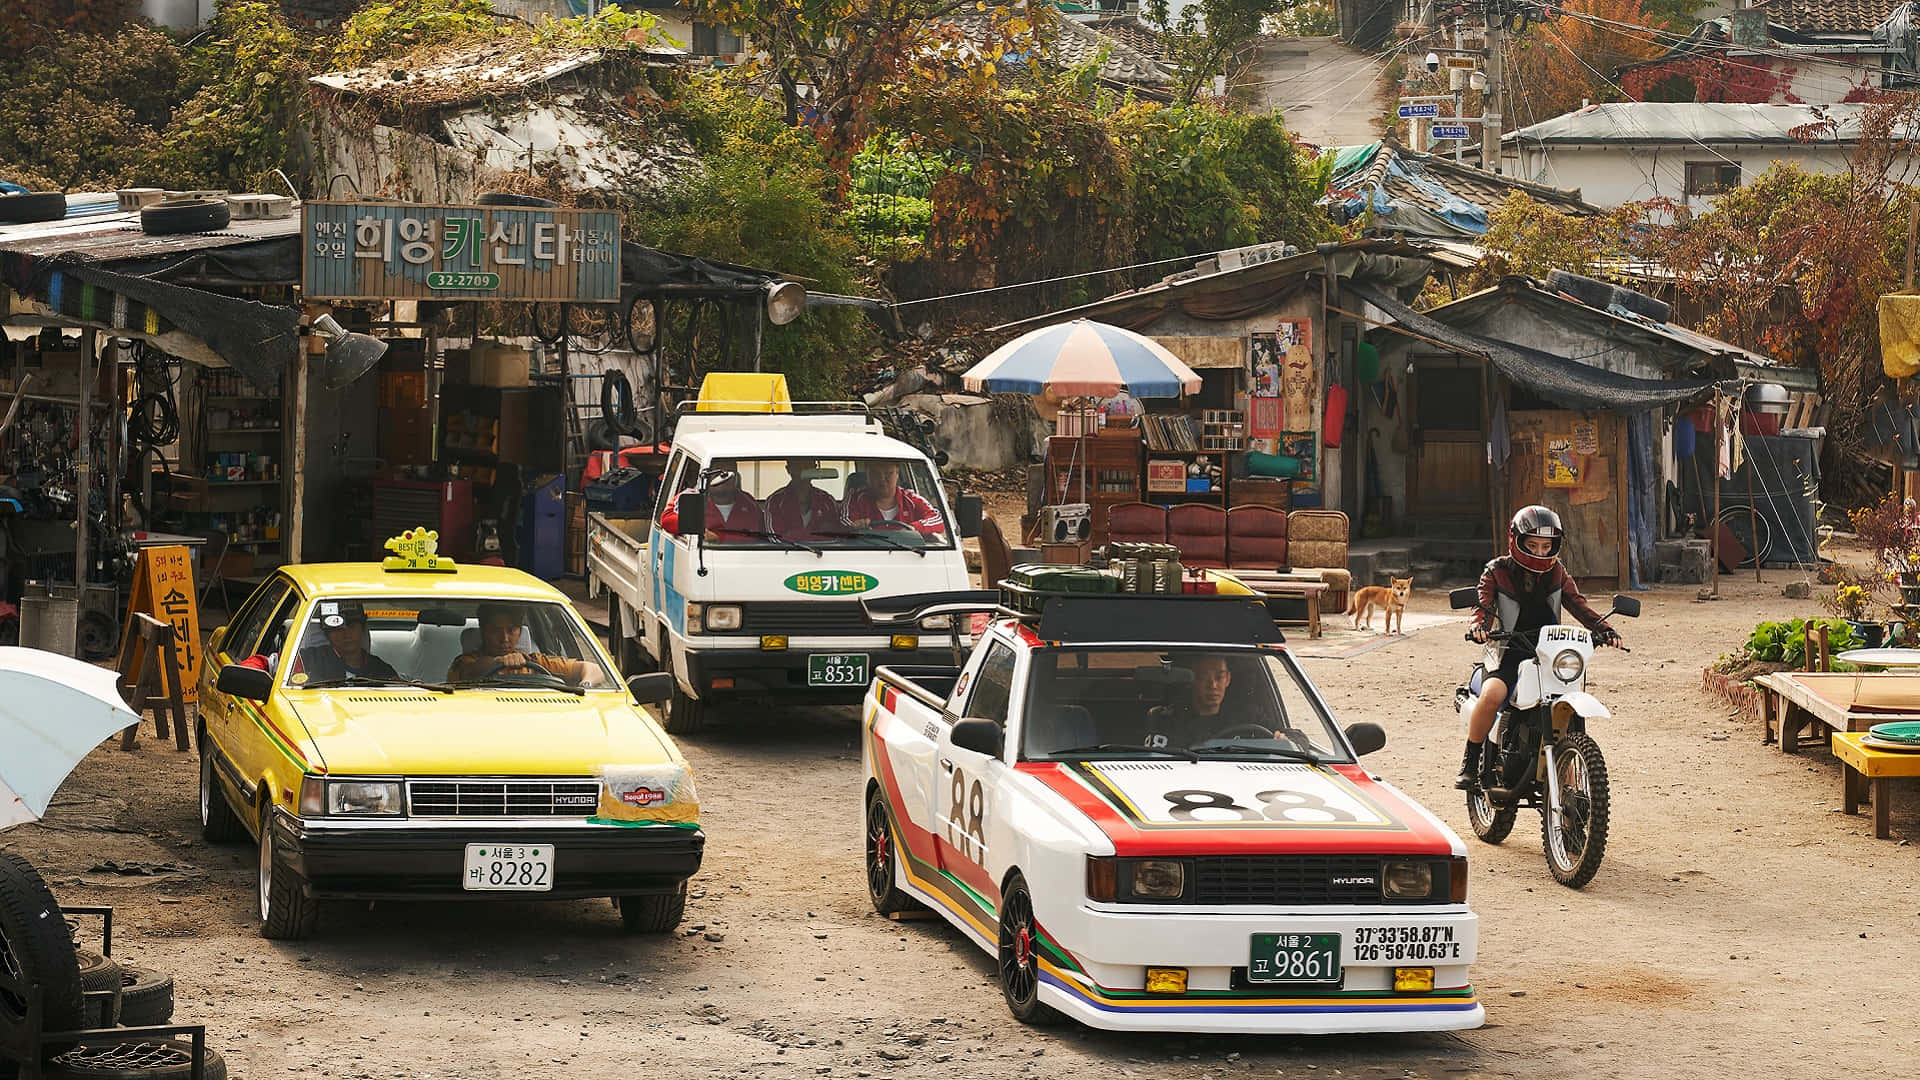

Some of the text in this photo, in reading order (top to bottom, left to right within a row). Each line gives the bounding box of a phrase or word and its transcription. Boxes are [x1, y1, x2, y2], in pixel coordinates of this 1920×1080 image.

[354, 215, 571, 267] 희영카센타
[315, 242, 345, 259] 오일
[437, 275, 490, 287] 32-2709
[398, 542, 413, 552] BEST
[796, 575, 867, 592] 희영카센타
[1547, 627, 1588, 643] HUSTLER
[826, 656, 849, 665] 서울 7
[812, 665, 863, 682] 고 8531
[555, 796, 595, 804] HYUNDAI
[1163, 789, 1358, 822] 88
[948, 767, 985, 868] 88
[491, 847, 525, 859] 서울 3
[470, 862, 547, 886] 바 8282
[1276, 935, 1312, 948] 서울 2
[1253, 950, 1333, 977] 고 9861
